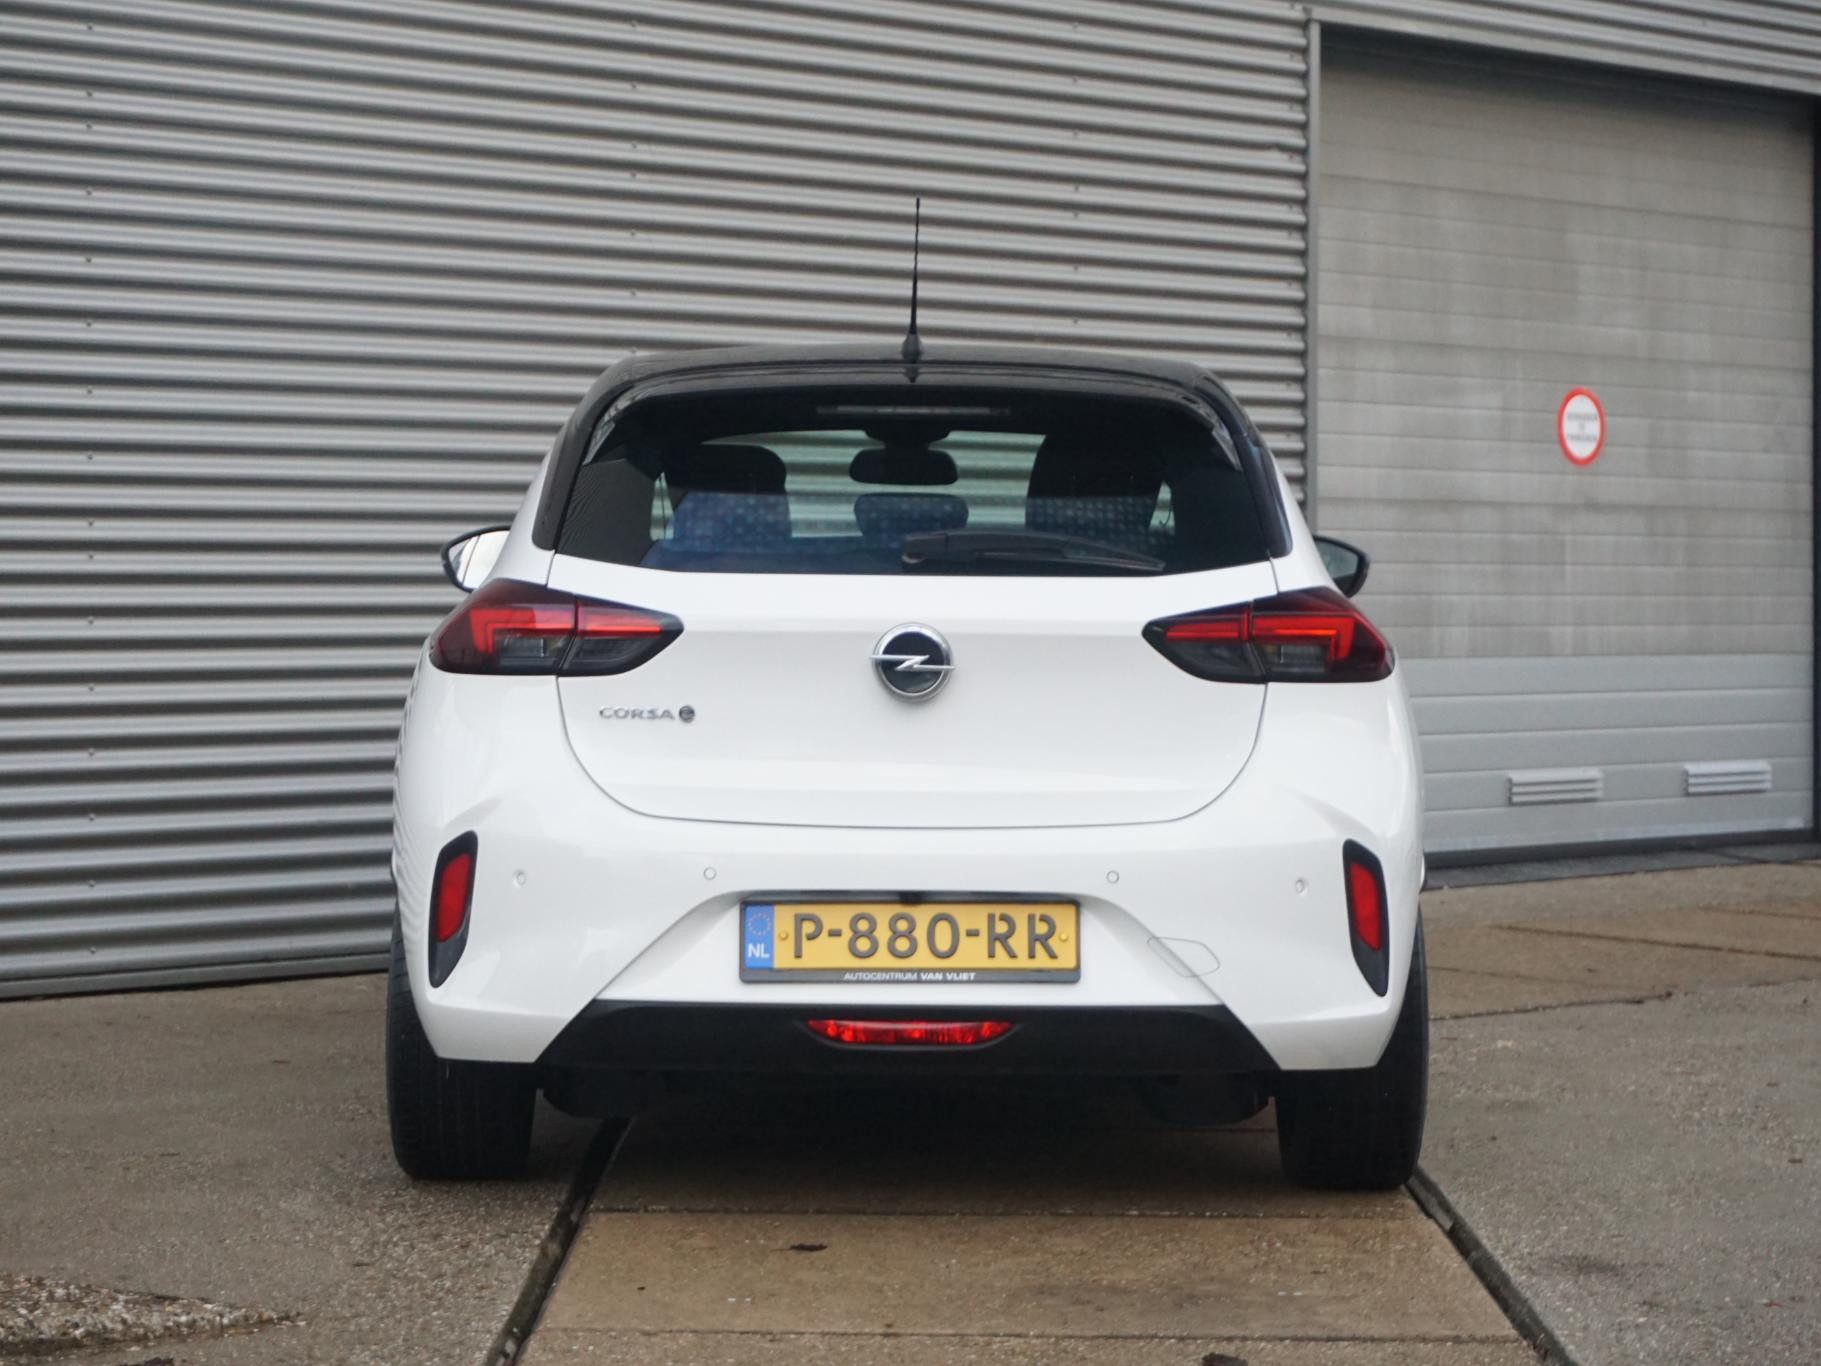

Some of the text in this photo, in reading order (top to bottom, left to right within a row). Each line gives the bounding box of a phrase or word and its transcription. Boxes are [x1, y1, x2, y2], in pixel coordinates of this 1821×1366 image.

[599, 707, 675, 720] CORSA
[794, 912, 1059, 959] P-880-RR
[748, 943, 769, 958] NL
[843, 972, 976, 981] AUTOCENTRUM VAN VLIET
